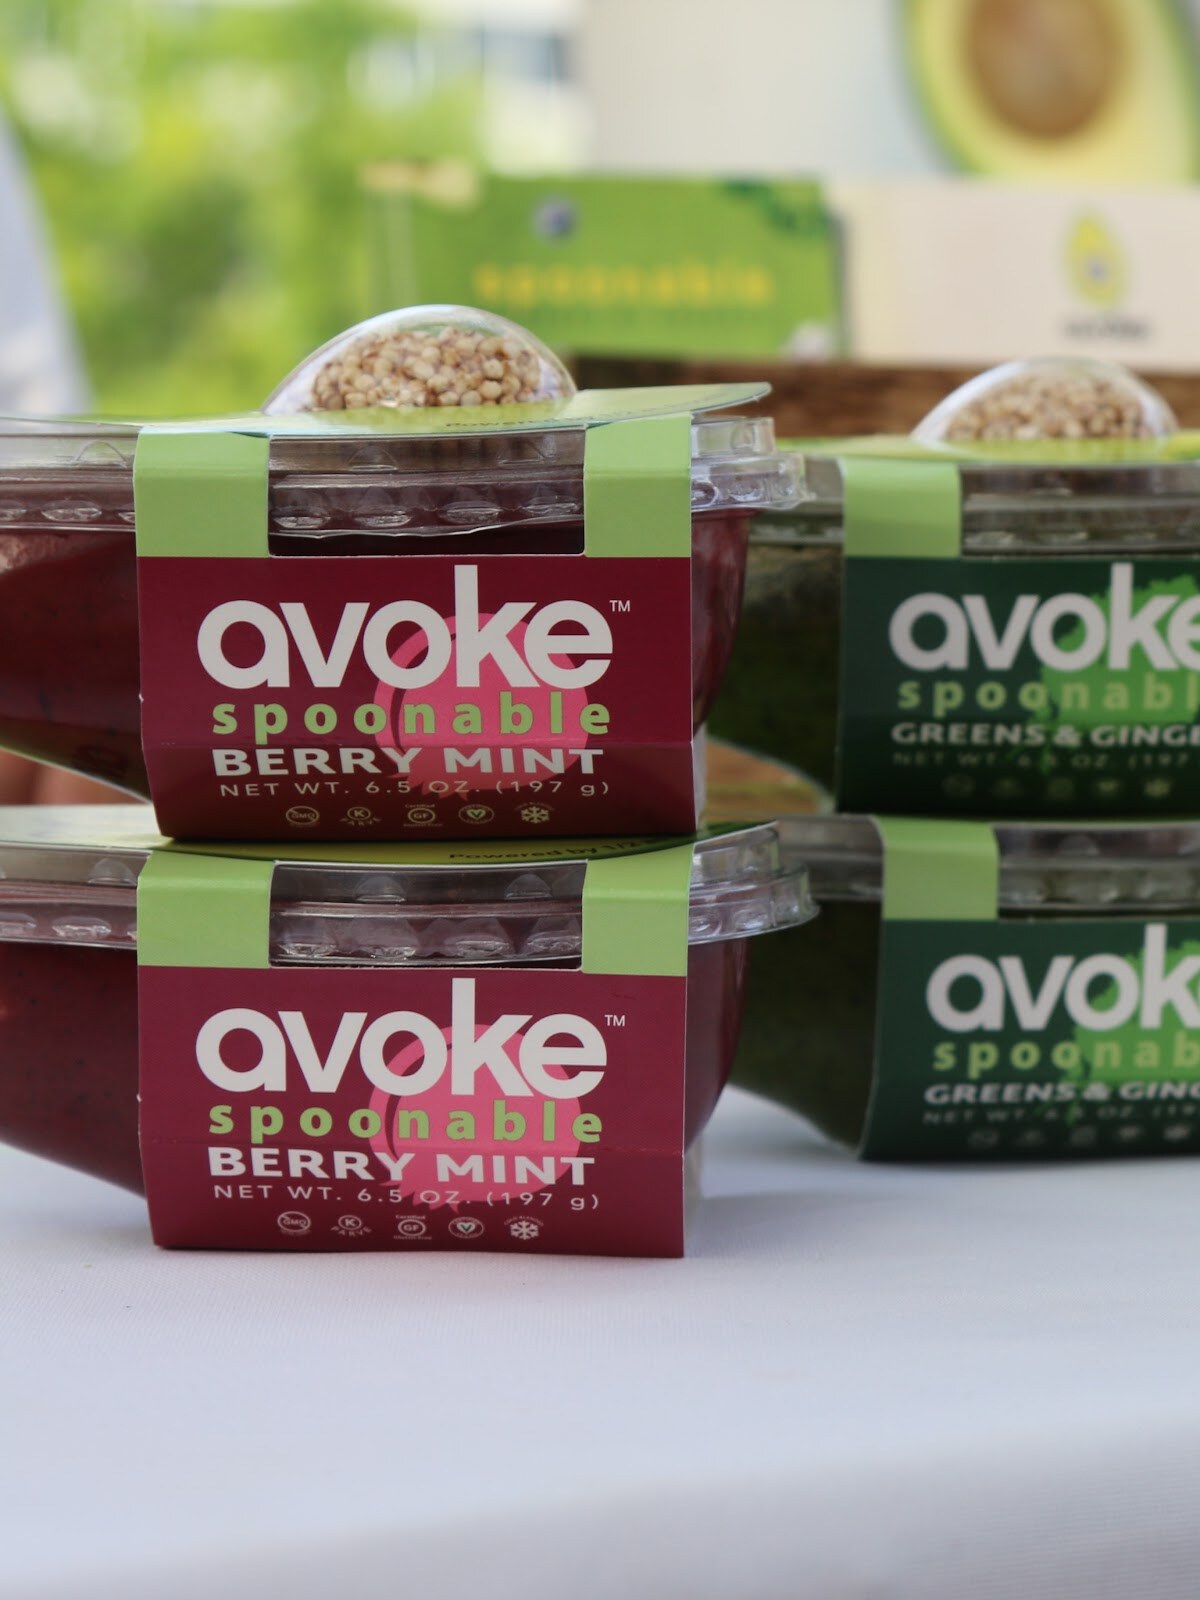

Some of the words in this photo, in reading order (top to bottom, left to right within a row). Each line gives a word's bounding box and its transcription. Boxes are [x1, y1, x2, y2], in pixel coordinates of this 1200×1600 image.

[197, 563, 613, 690] avoke
[212, 691, 611, 745] spoonable
[891, 722, 1046, 746] GREENS
[1053, 724, 1081, 747] &
[212, 747, 422, 778] BERRY
[445, 748, 605, 775] MINT
[220, 782, 276, 797] NET
[294, 781, 350, 795] WT.
[366, 780, 410, 794] 6.5
[428, 780, 480, 794] OZ.
[496, 780, 562, 795] (197
[581, 780, 610, 797] g)
[449, 849, 562, 859] Powered
[196, 977, 607, 1098] avoke
[924, 1081, 1077, 1104] GREENS
[1083, 1081, 1110, 1101] &
[209, 1100, 602, 1143] spoonable
[208, 1146, 415, 1182] BERRY
[436, 1153, 595, 1185] MINT
[214, 1184, 272, 1199] NET
[287, 1185, 341, 1200] WT.
[357, 1187, 401, 1203] 6.5
[419, 1189, 471, 1204] OZ.
[486, 1191, 552, 1207] (197
[571, 1194, 599, 1211] g)
